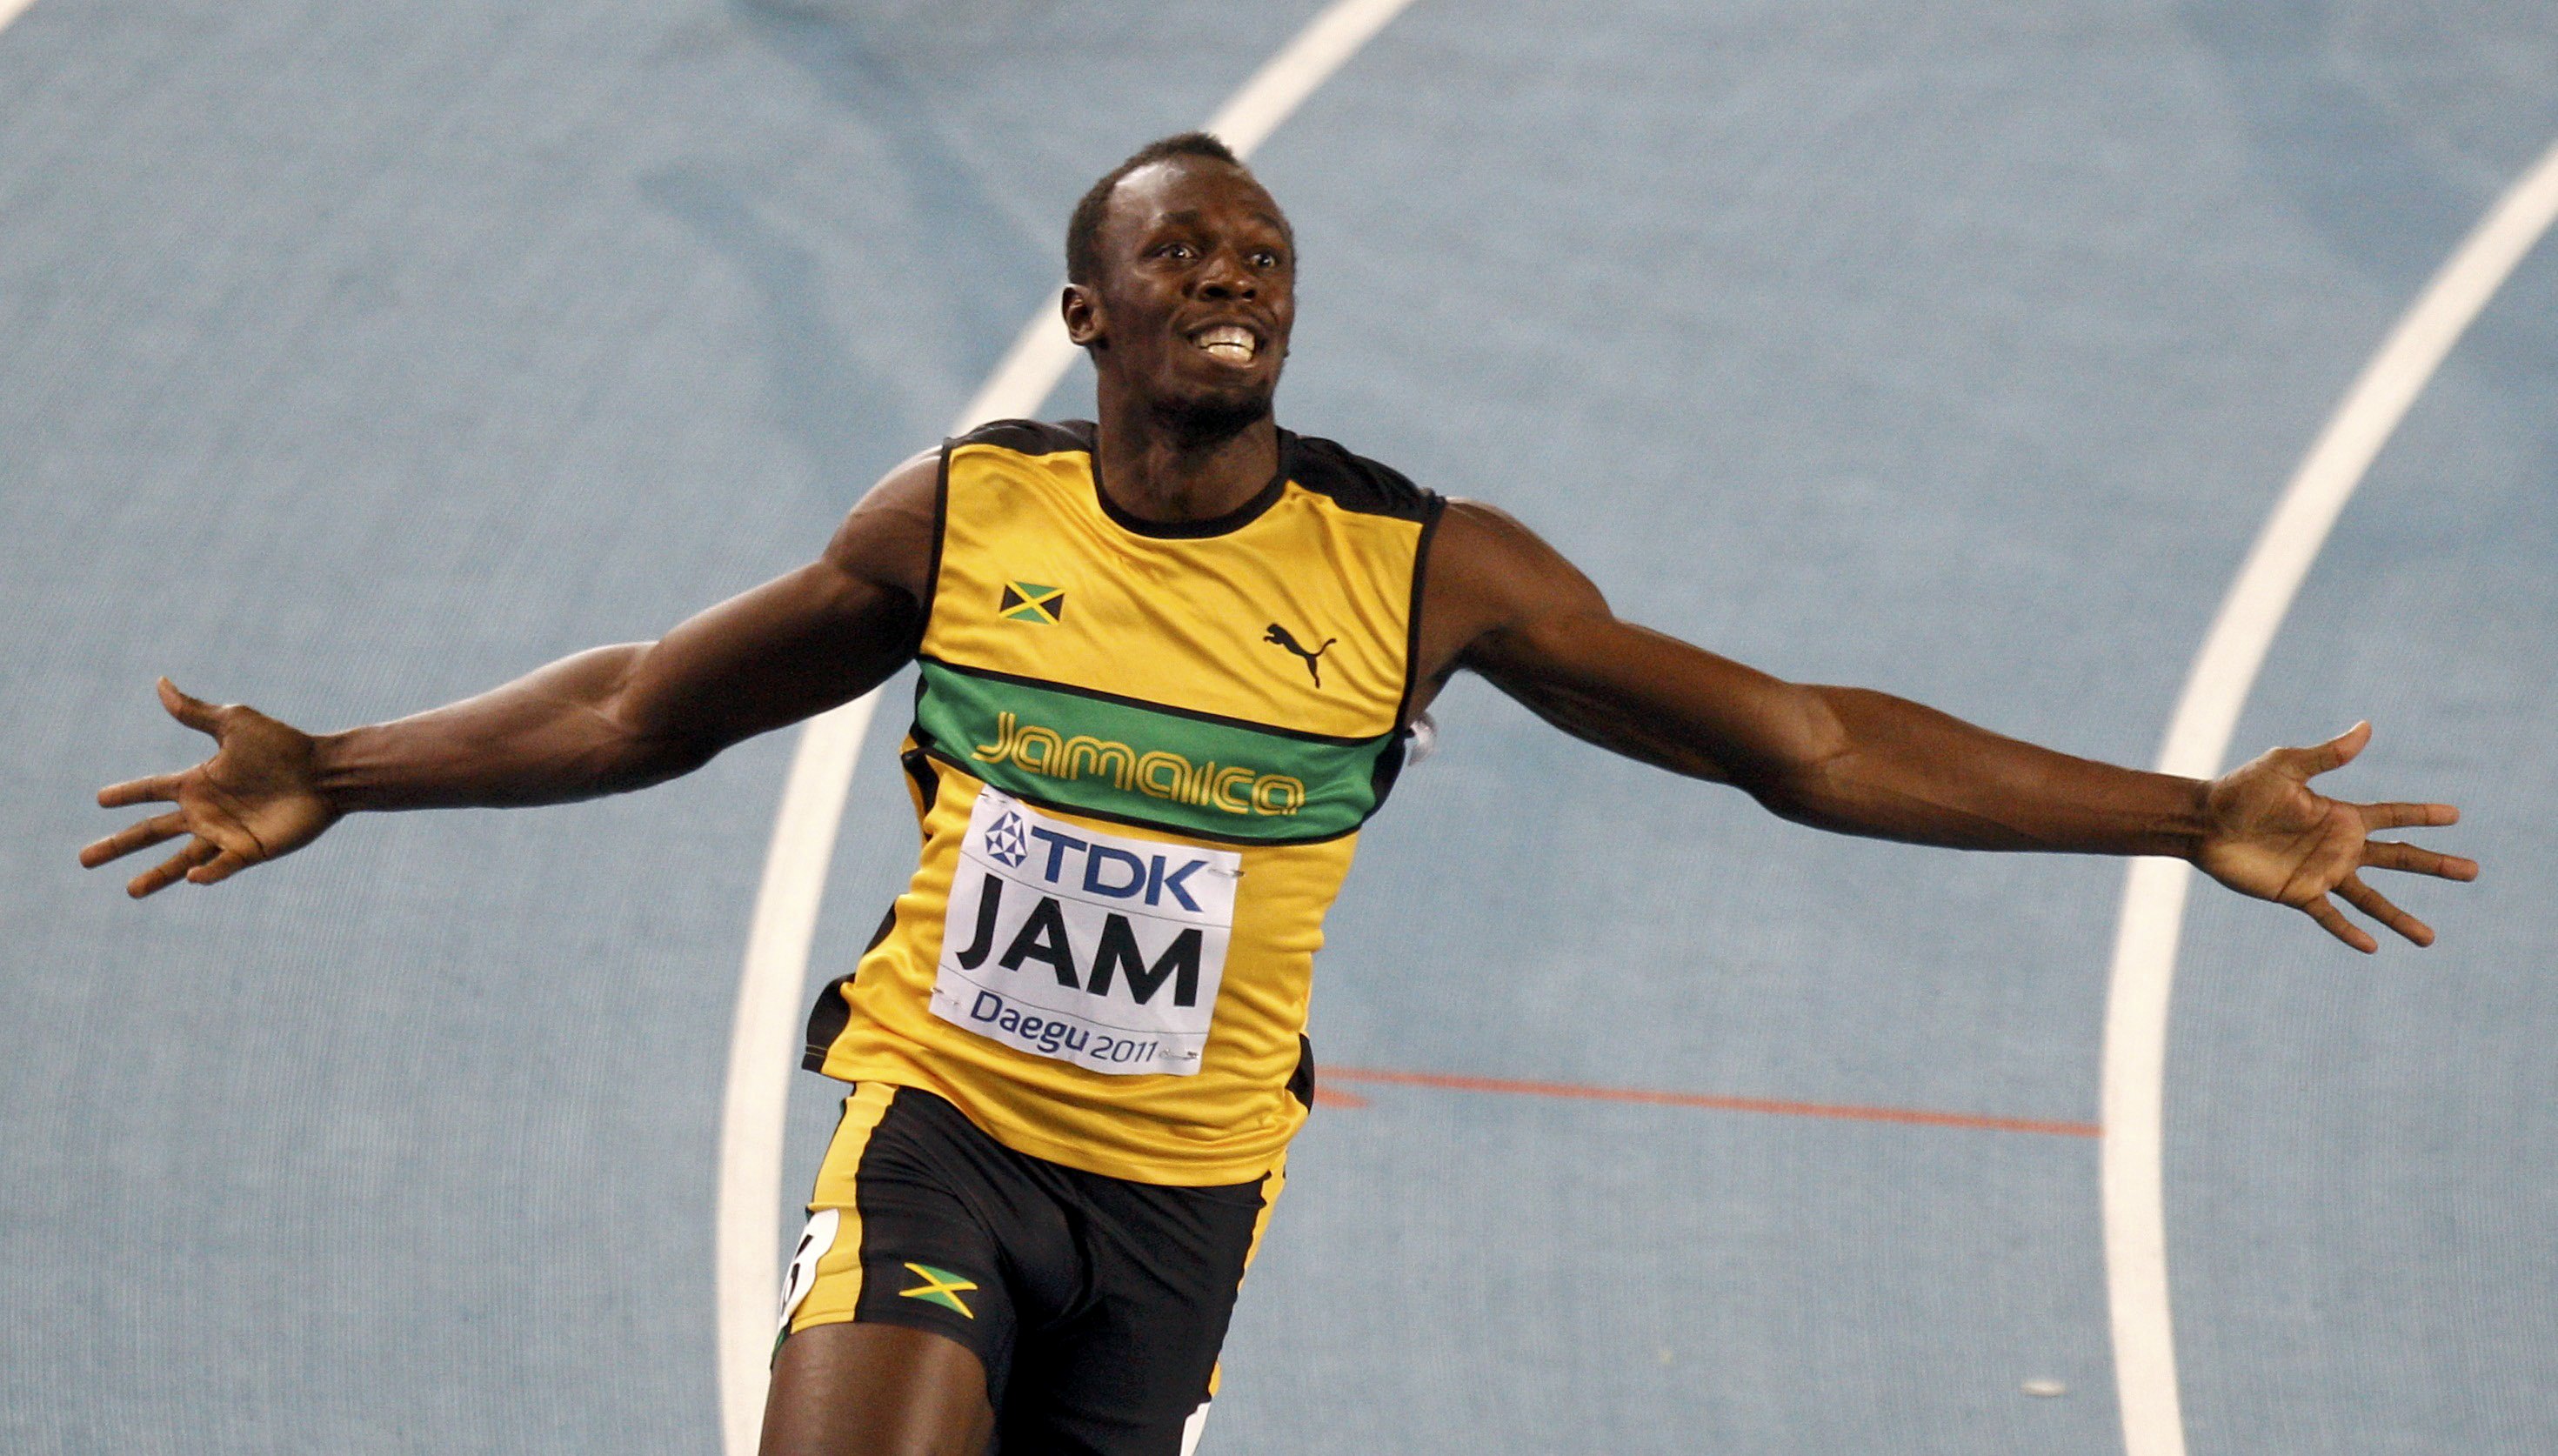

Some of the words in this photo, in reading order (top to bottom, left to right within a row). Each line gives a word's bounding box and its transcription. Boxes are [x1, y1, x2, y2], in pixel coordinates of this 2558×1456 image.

[1031, 826, 1209, 913] TDK
[955, 873, 1202, 1007] JAM
[970, 990, 1091, 1054] Daegu
[1090, 1035, 1159, 1063] 2011
